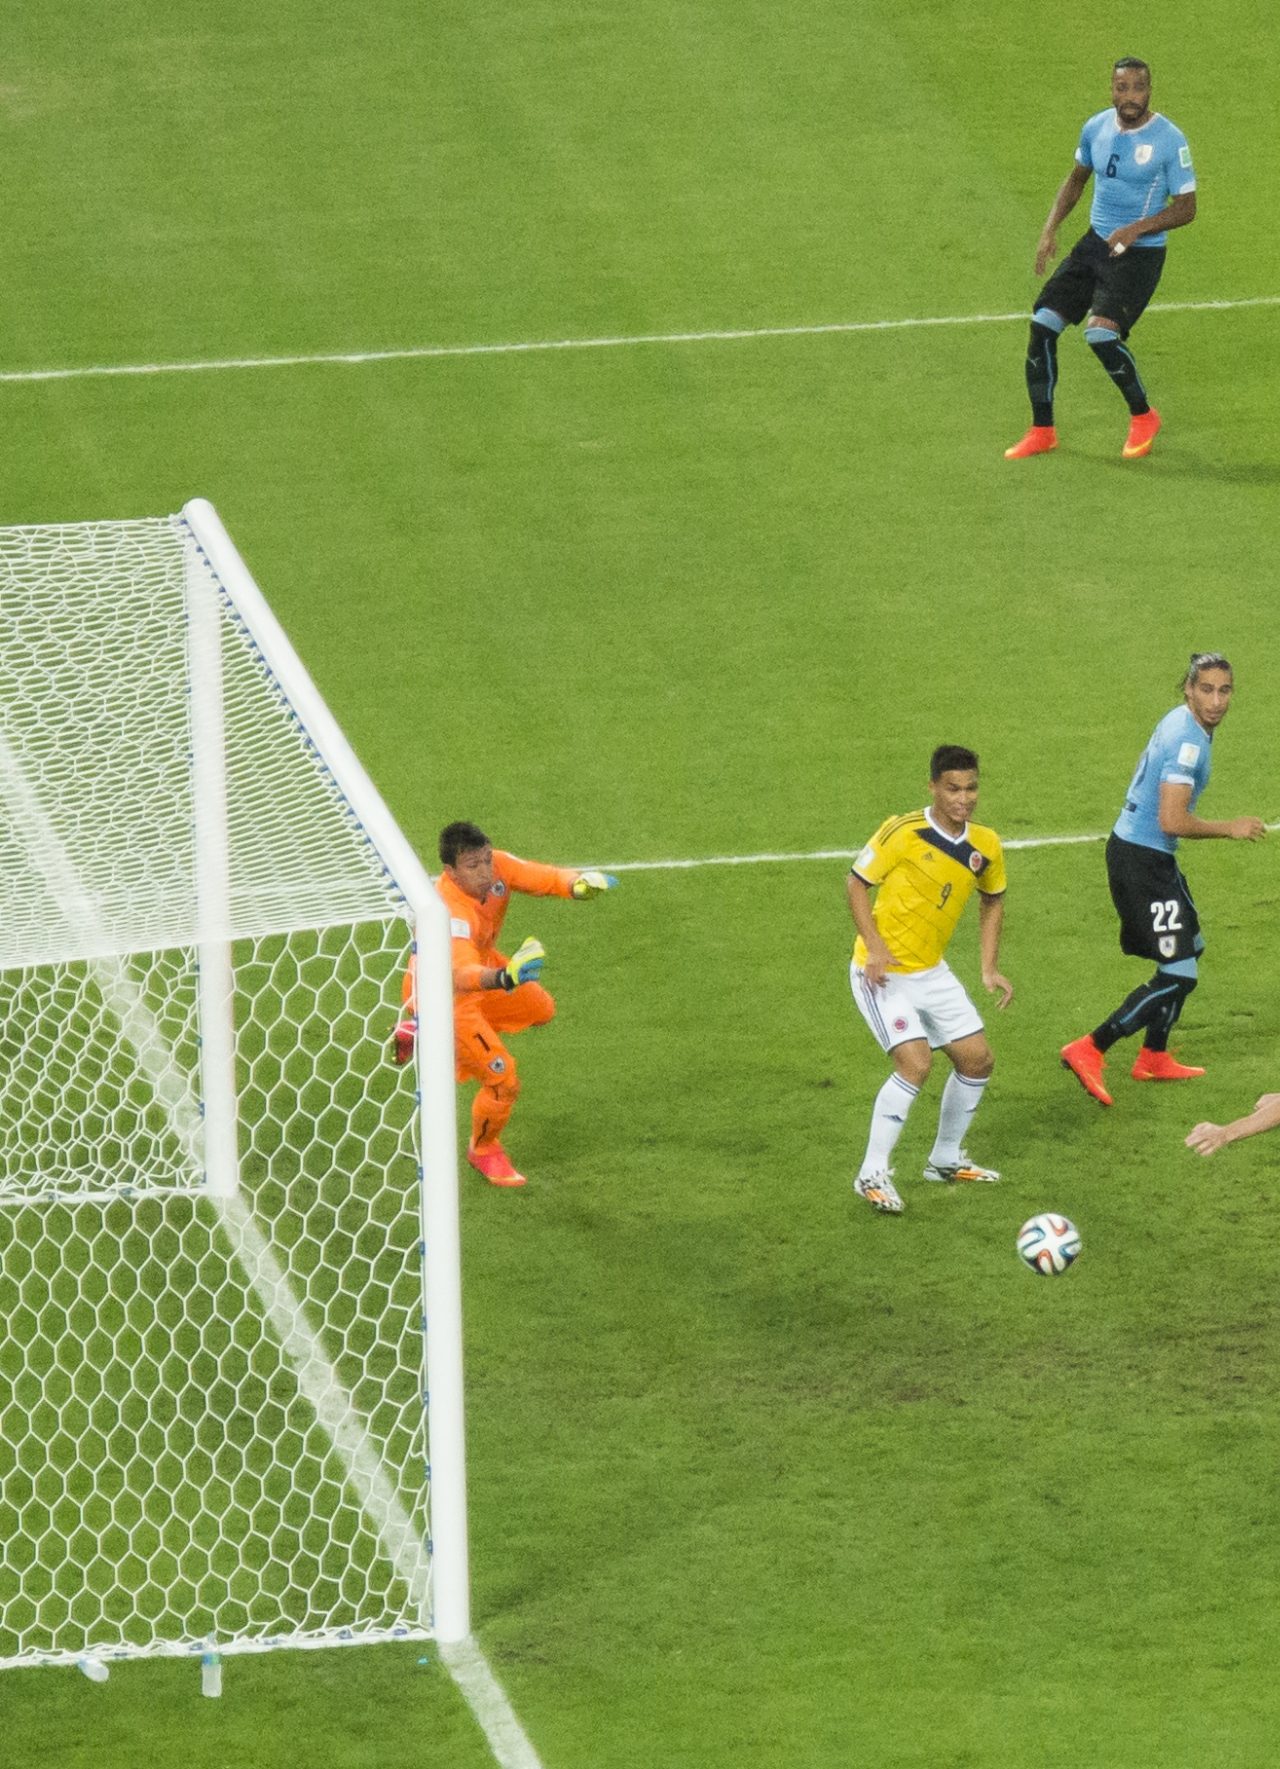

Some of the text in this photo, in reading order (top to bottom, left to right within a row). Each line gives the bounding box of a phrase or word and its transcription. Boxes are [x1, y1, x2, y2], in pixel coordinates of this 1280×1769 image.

[1106, 153, 1120, 178] 6
[936, 881, 952, 910] 9
[1150, 900, 1182, 932] 22
